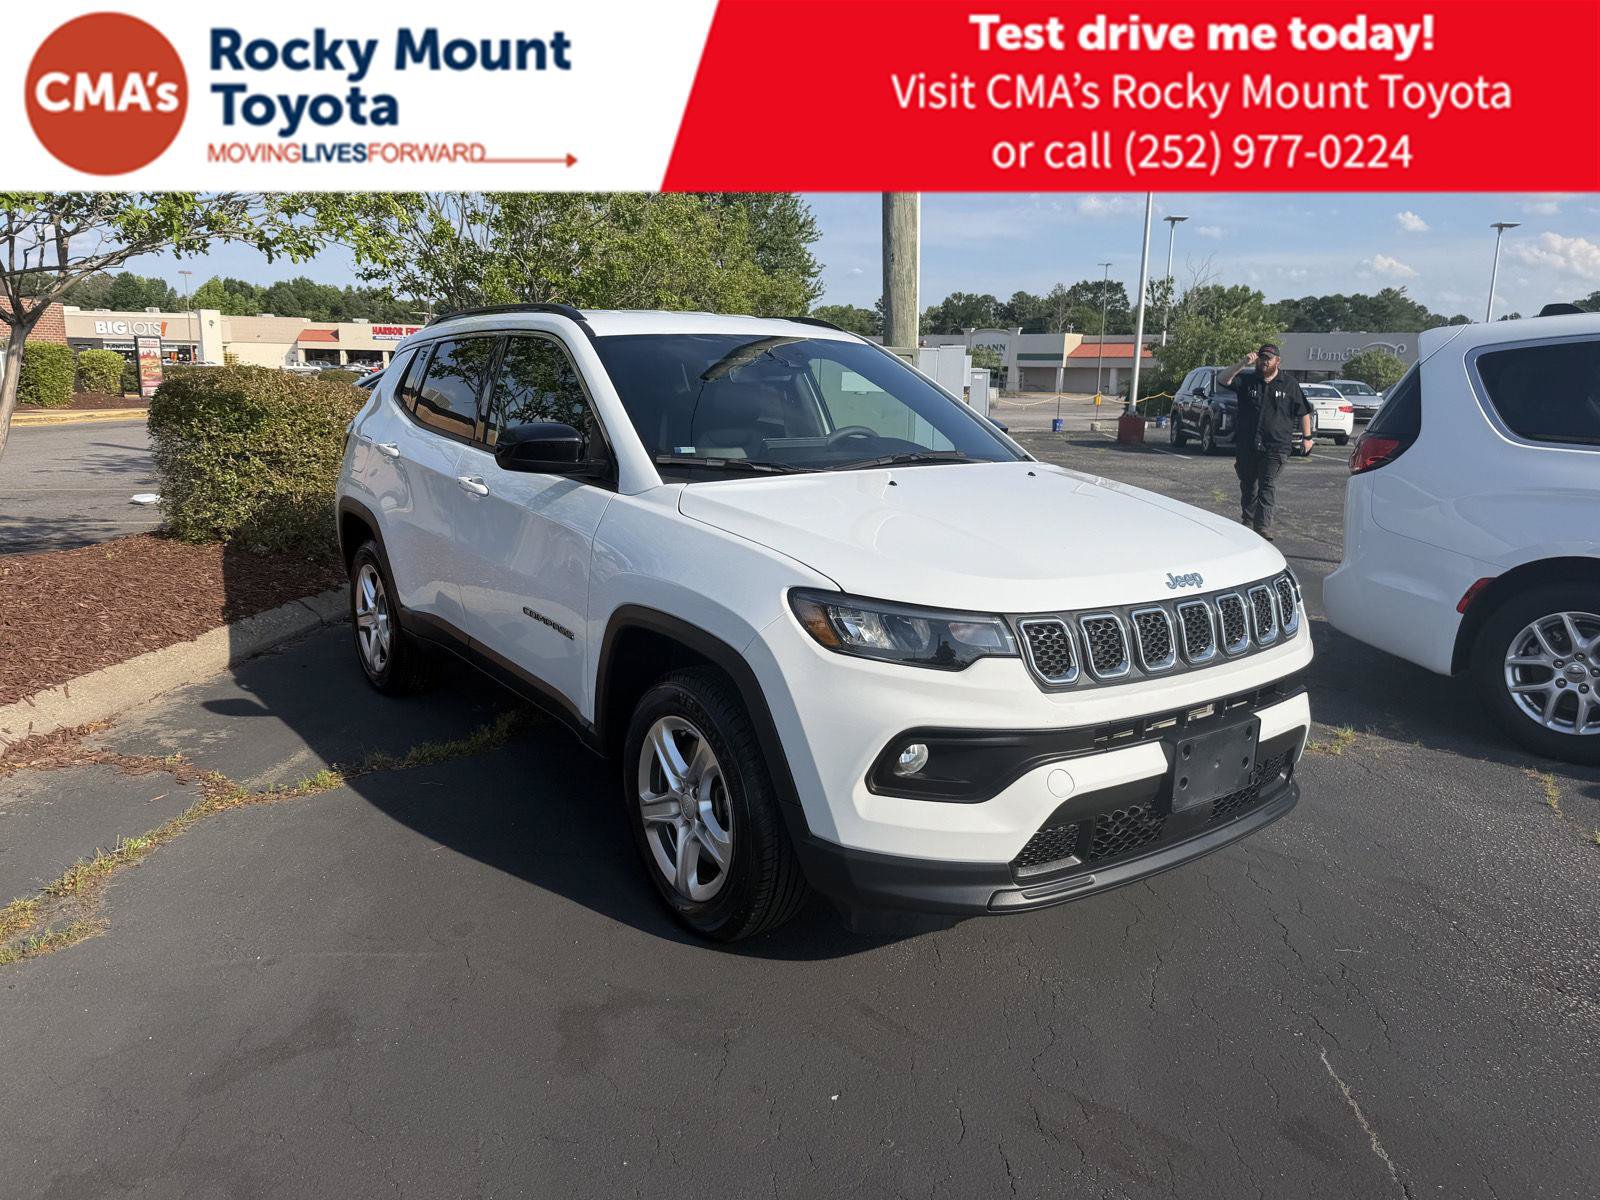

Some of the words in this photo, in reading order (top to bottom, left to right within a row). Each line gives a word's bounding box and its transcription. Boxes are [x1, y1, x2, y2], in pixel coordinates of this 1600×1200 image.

[95, 320, 127, 335] BIG
[372, 326, 403, 336] HARBOR
[1165, 572, 1204, 589] Jeep
